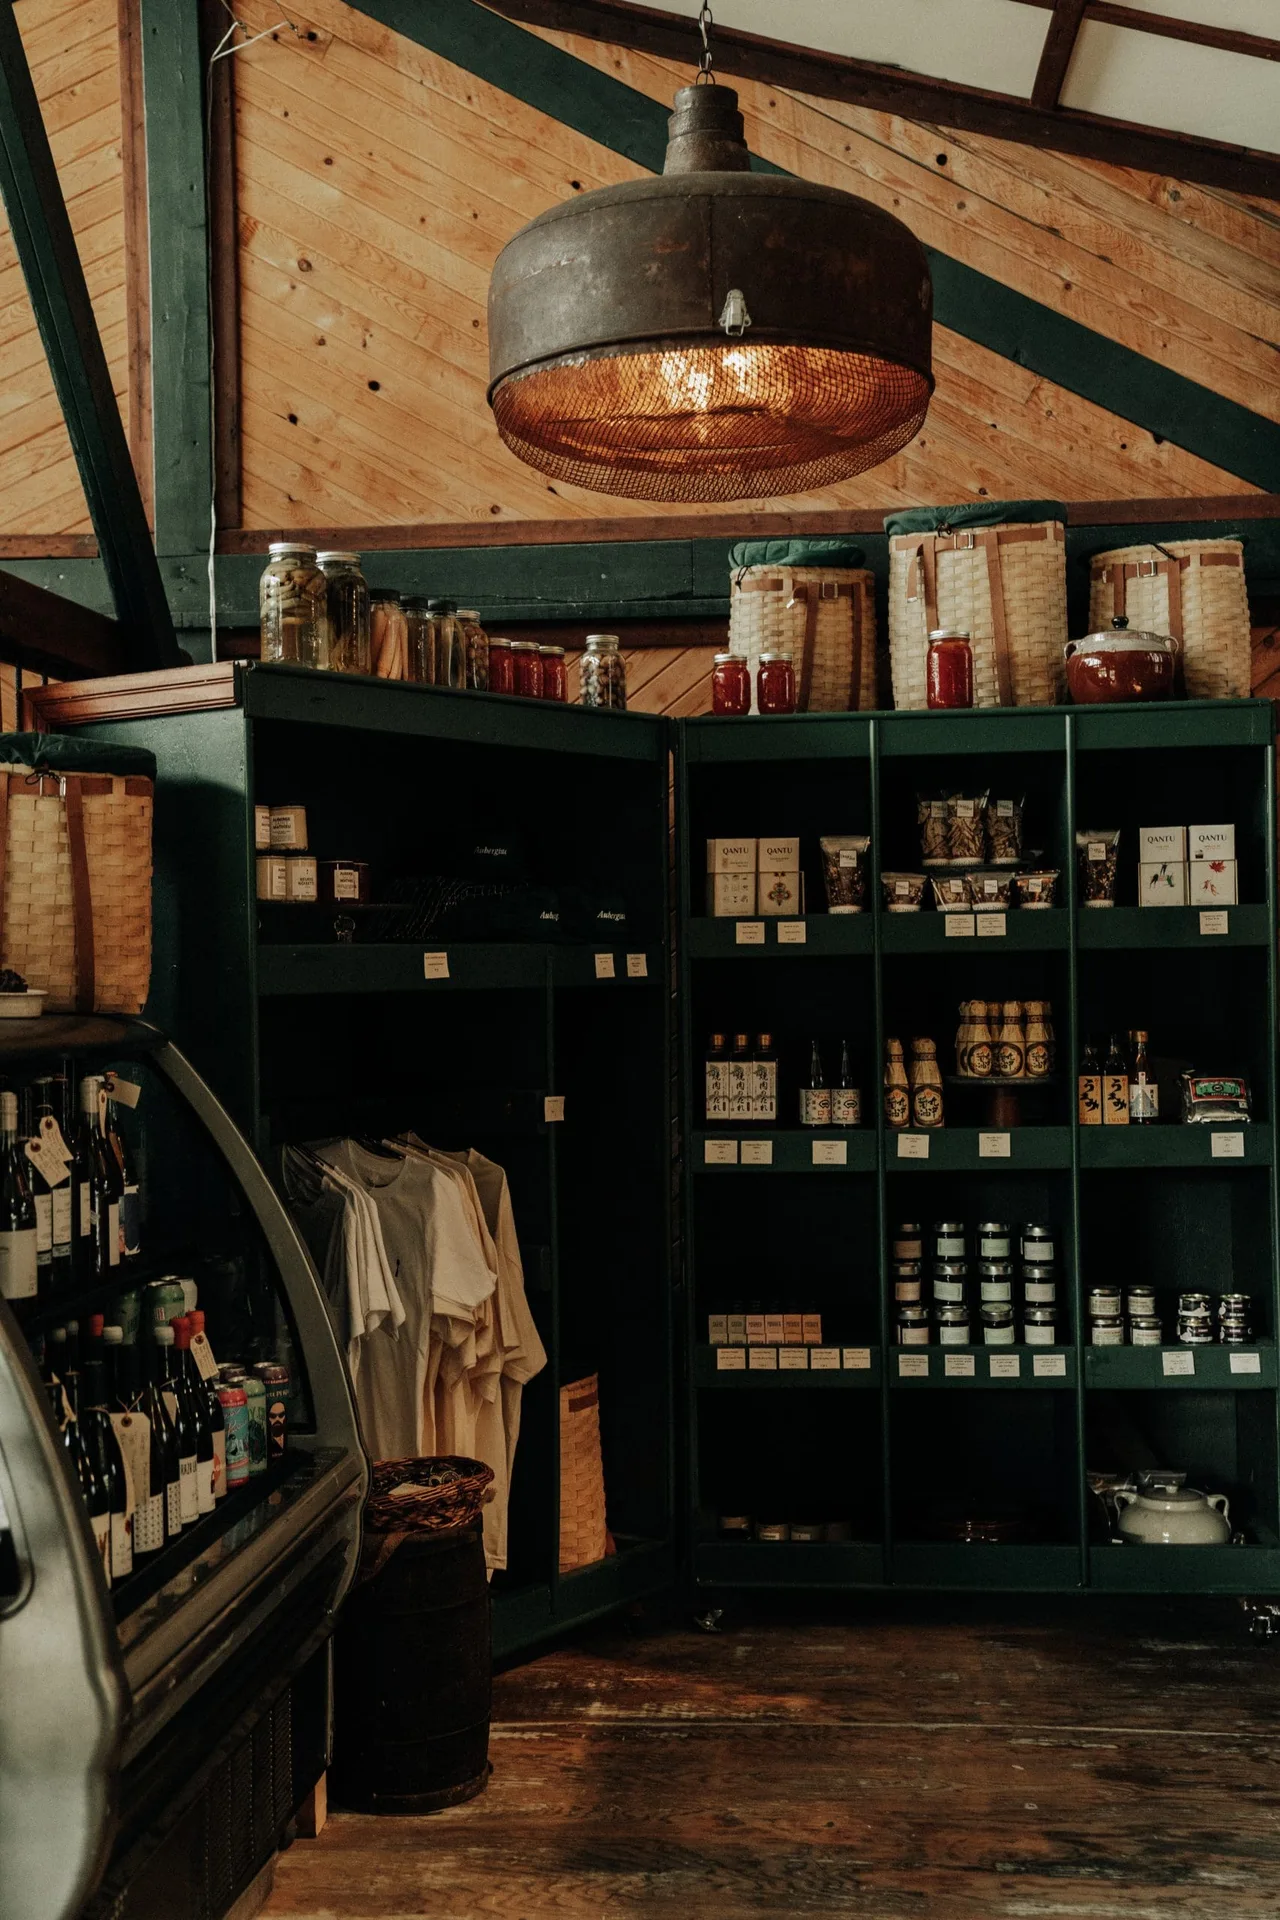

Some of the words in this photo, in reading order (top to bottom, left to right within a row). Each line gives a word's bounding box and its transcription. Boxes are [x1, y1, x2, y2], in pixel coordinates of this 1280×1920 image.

[1147, 835, 1175, 844] QANTU
[1198, 834, 1227, 842] QANTU
[722, 847, 749, 855] QANTU
[766, 847, 793, 855] QANTU
